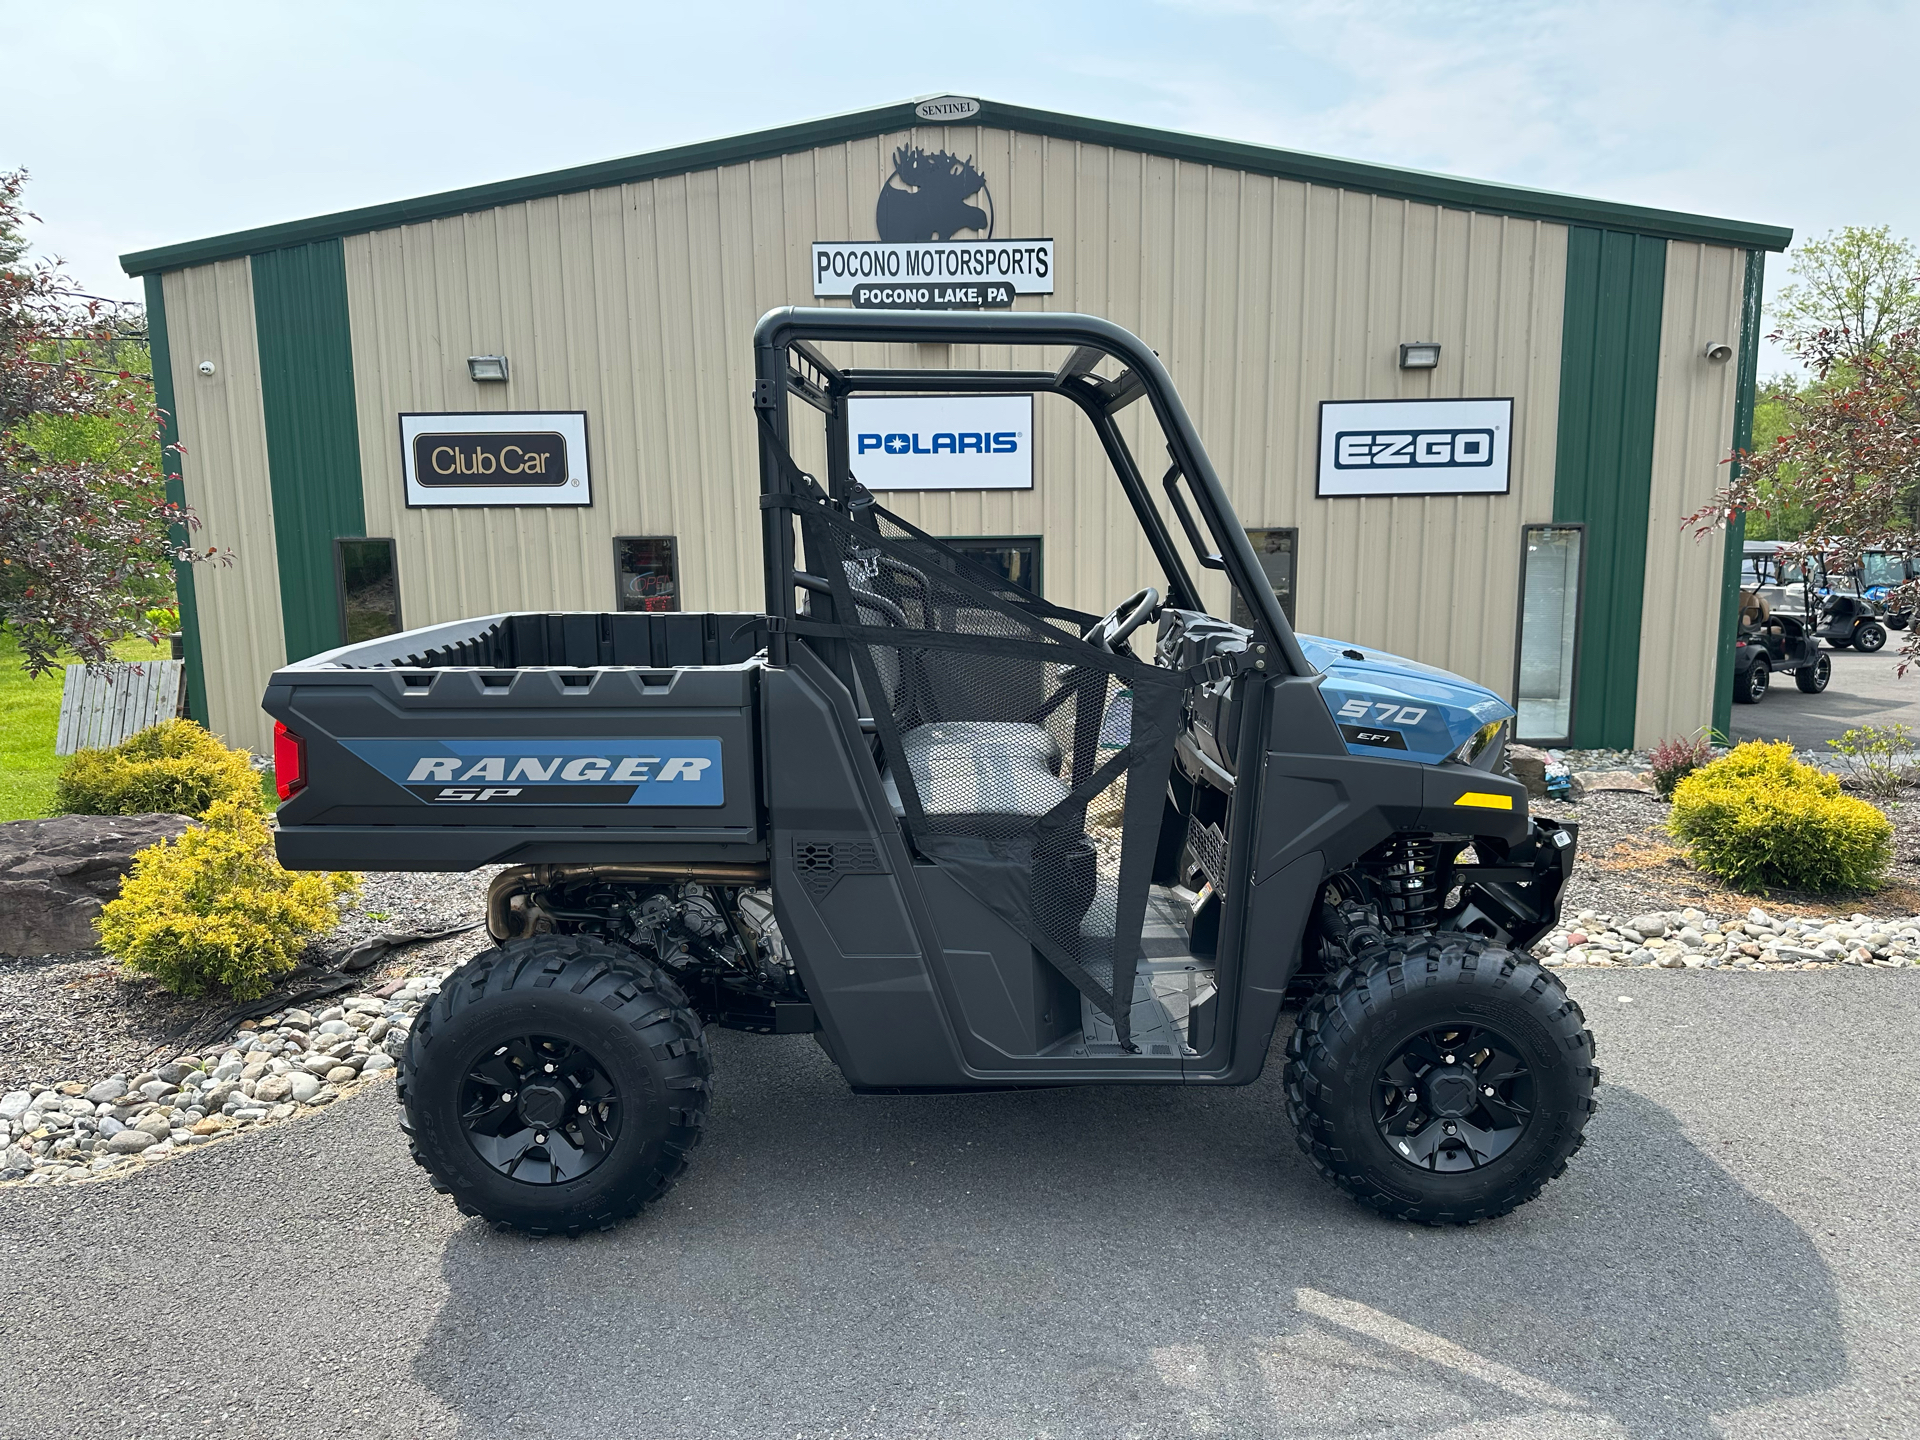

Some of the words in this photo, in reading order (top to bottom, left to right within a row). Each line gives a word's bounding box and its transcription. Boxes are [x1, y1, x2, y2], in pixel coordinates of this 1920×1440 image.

[922, 101, 975, 116] SENTINEL
[817, 250, 900, 284] POCONO
[906, 247, 1049, 278] MOTORSPORTS
[860, 288, 929, 304] POCONO
[934, 287, 983, 305] LAKE,
[987, 287, 1008, 302] PA
[857, 431, 1018, 455] POLARIS
[1338, 433, 1490, 466] EZGO
[431, 445, 497, 476] Club
[499, 444, 551, 475] Car
[1337, 698, 1428, 726] 570
[1356, 731, 1391, 743] EFI
[407, 756, 712, 782] RANGER
[434, 787, 523, 801] SP
[1507, 1110, 1570, 1188] CARLSTAR
